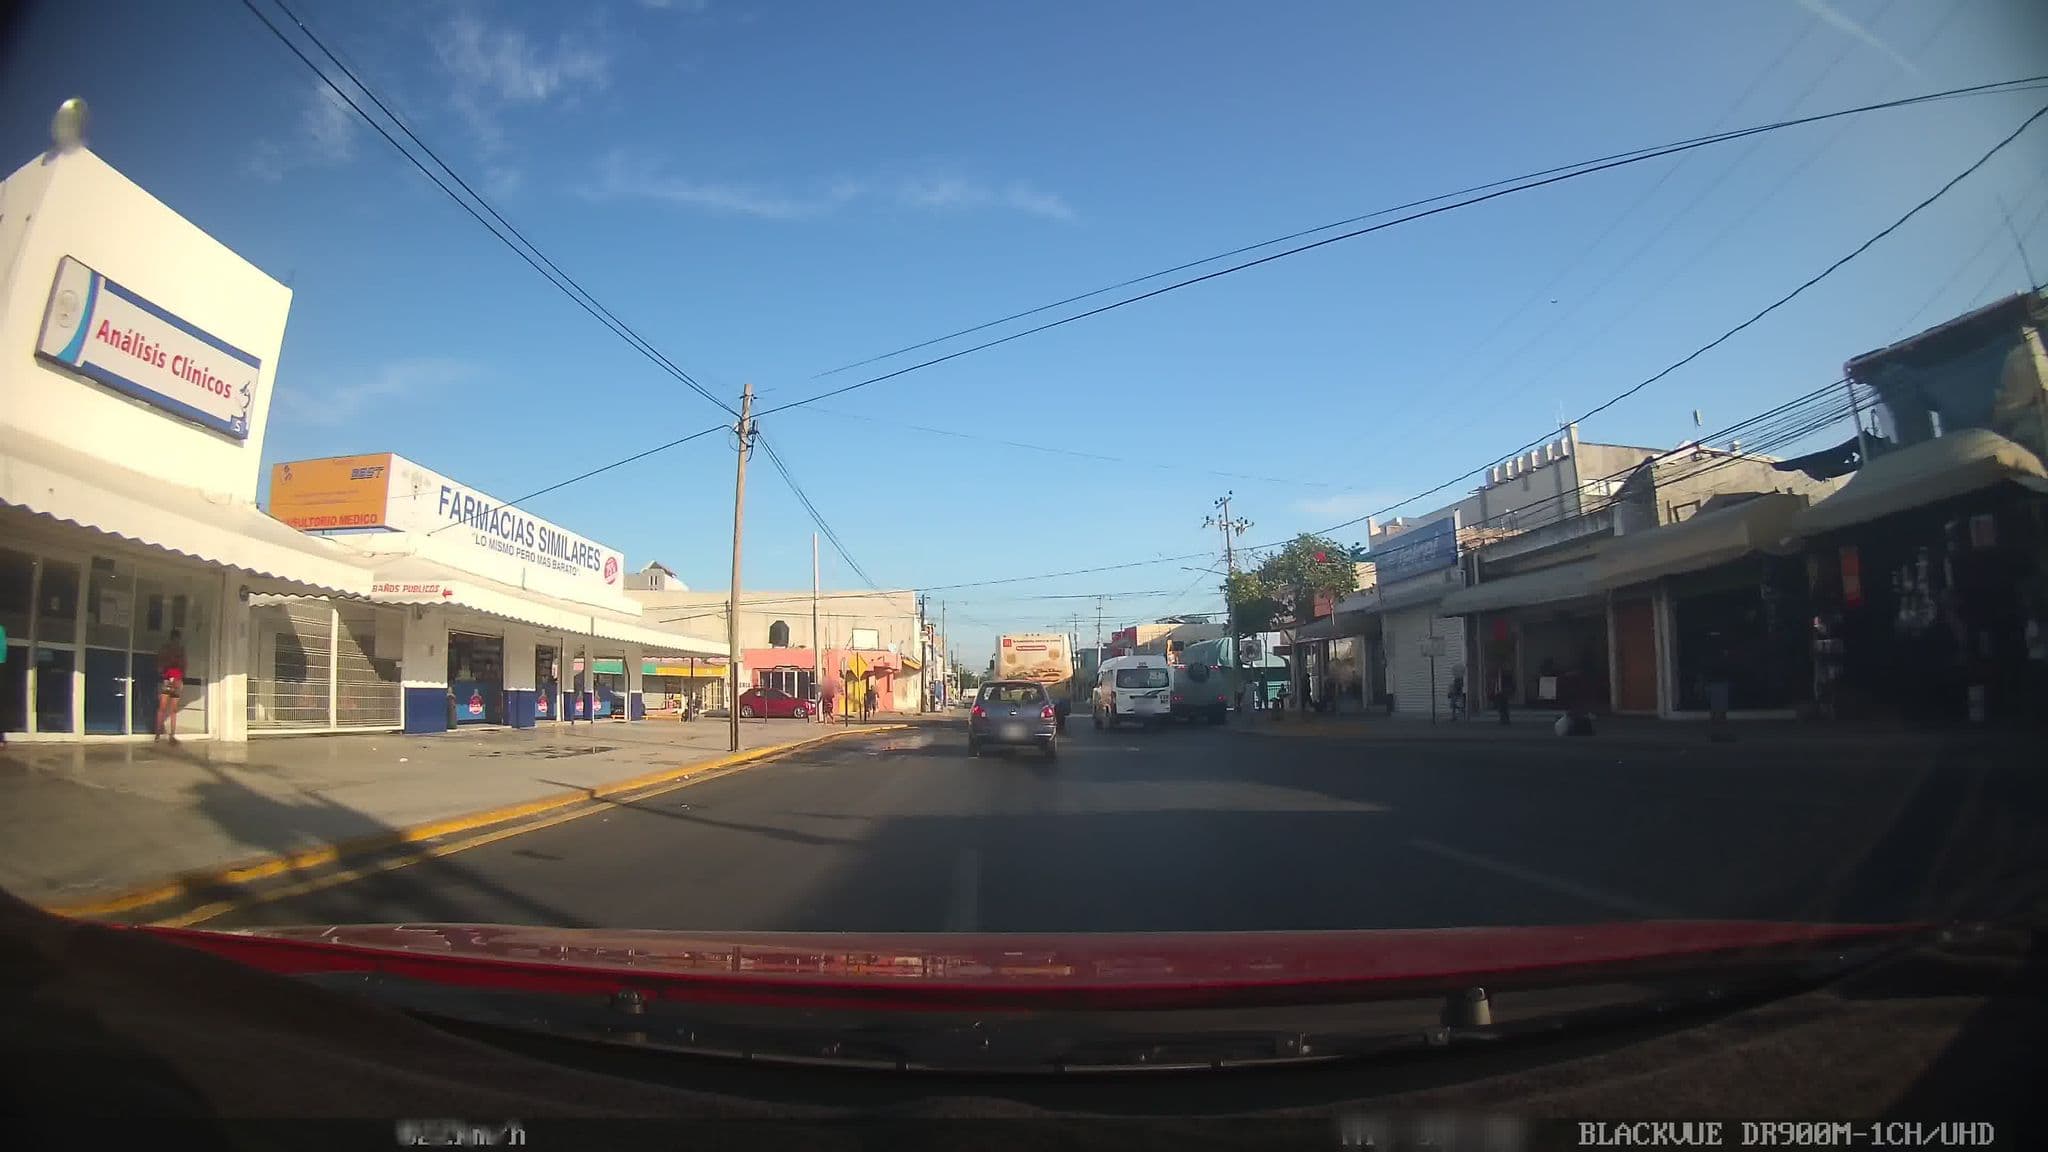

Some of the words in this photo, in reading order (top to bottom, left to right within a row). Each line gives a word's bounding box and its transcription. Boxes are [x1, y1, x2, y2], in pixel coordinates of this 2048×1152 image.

[96, 319, 166, 368] Análisis
[171, 354, 232, 399] Clínicos
[350, 466, 384, 480] BEST
[339, 513, 378, 525] MEDICO
[438, 485, 535, 548] FARMACIAS
[538, 526, 601, 571] SIMILARES
[488, 540, 515, 556] MISMO
[516, 547, 536, 562] PERO
[372, 583, 400, 592] BAÑOS
